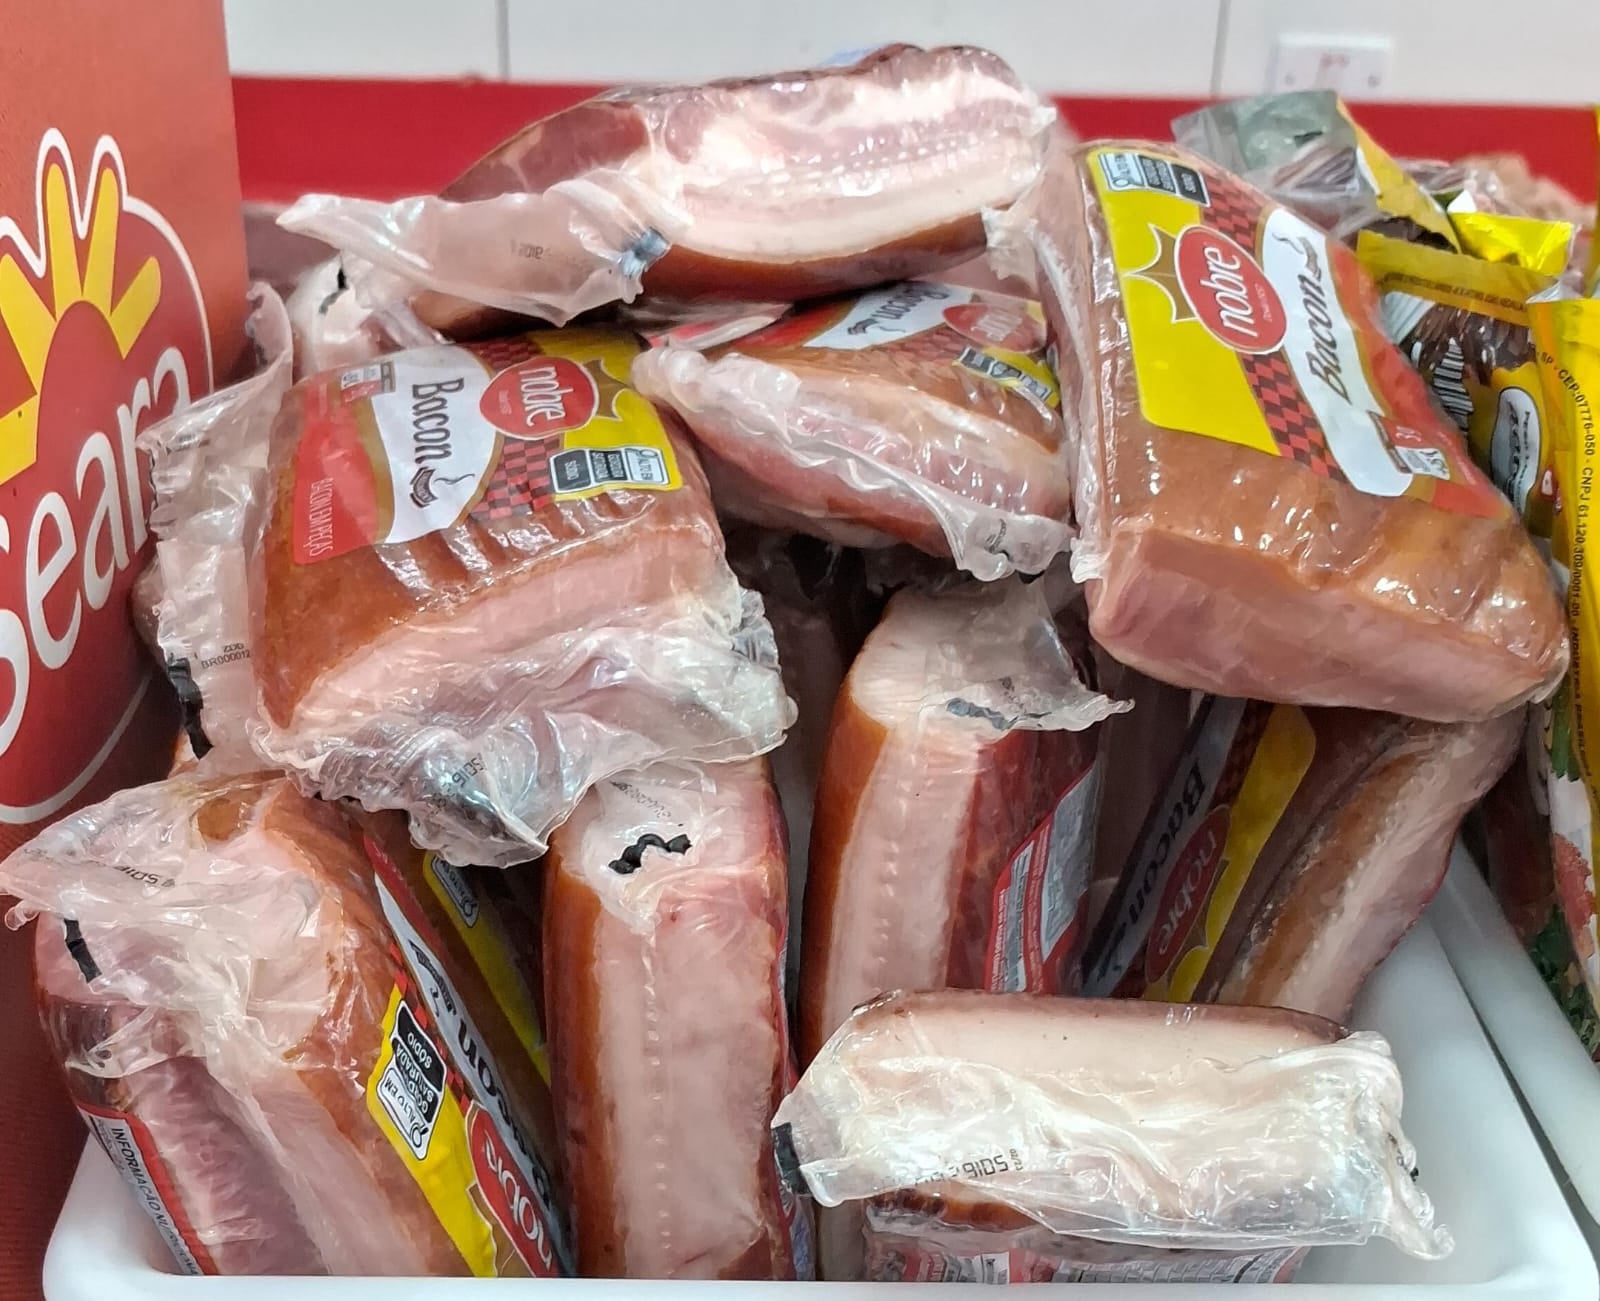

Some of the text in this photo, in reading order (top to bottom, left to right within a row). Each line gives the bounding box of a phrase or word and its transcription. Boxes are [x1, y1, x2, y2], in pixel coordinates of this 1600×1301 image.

[1201, 245, 1257, 337] nobre
[1297, 271, 1352, 405] Bacon
[412, 378, 465, 464] Bacon
[518, 366, 566, 428] nobre
[1578, 467, 1593, 501] CNPJ
[303, 524, 334, 557] PEÇAS
[1129, 761, 1206, 925] Bacon
[407, 1032, 433, 1069] SÓDIO
[384, 1077, 417, 1122] ALTO EM
